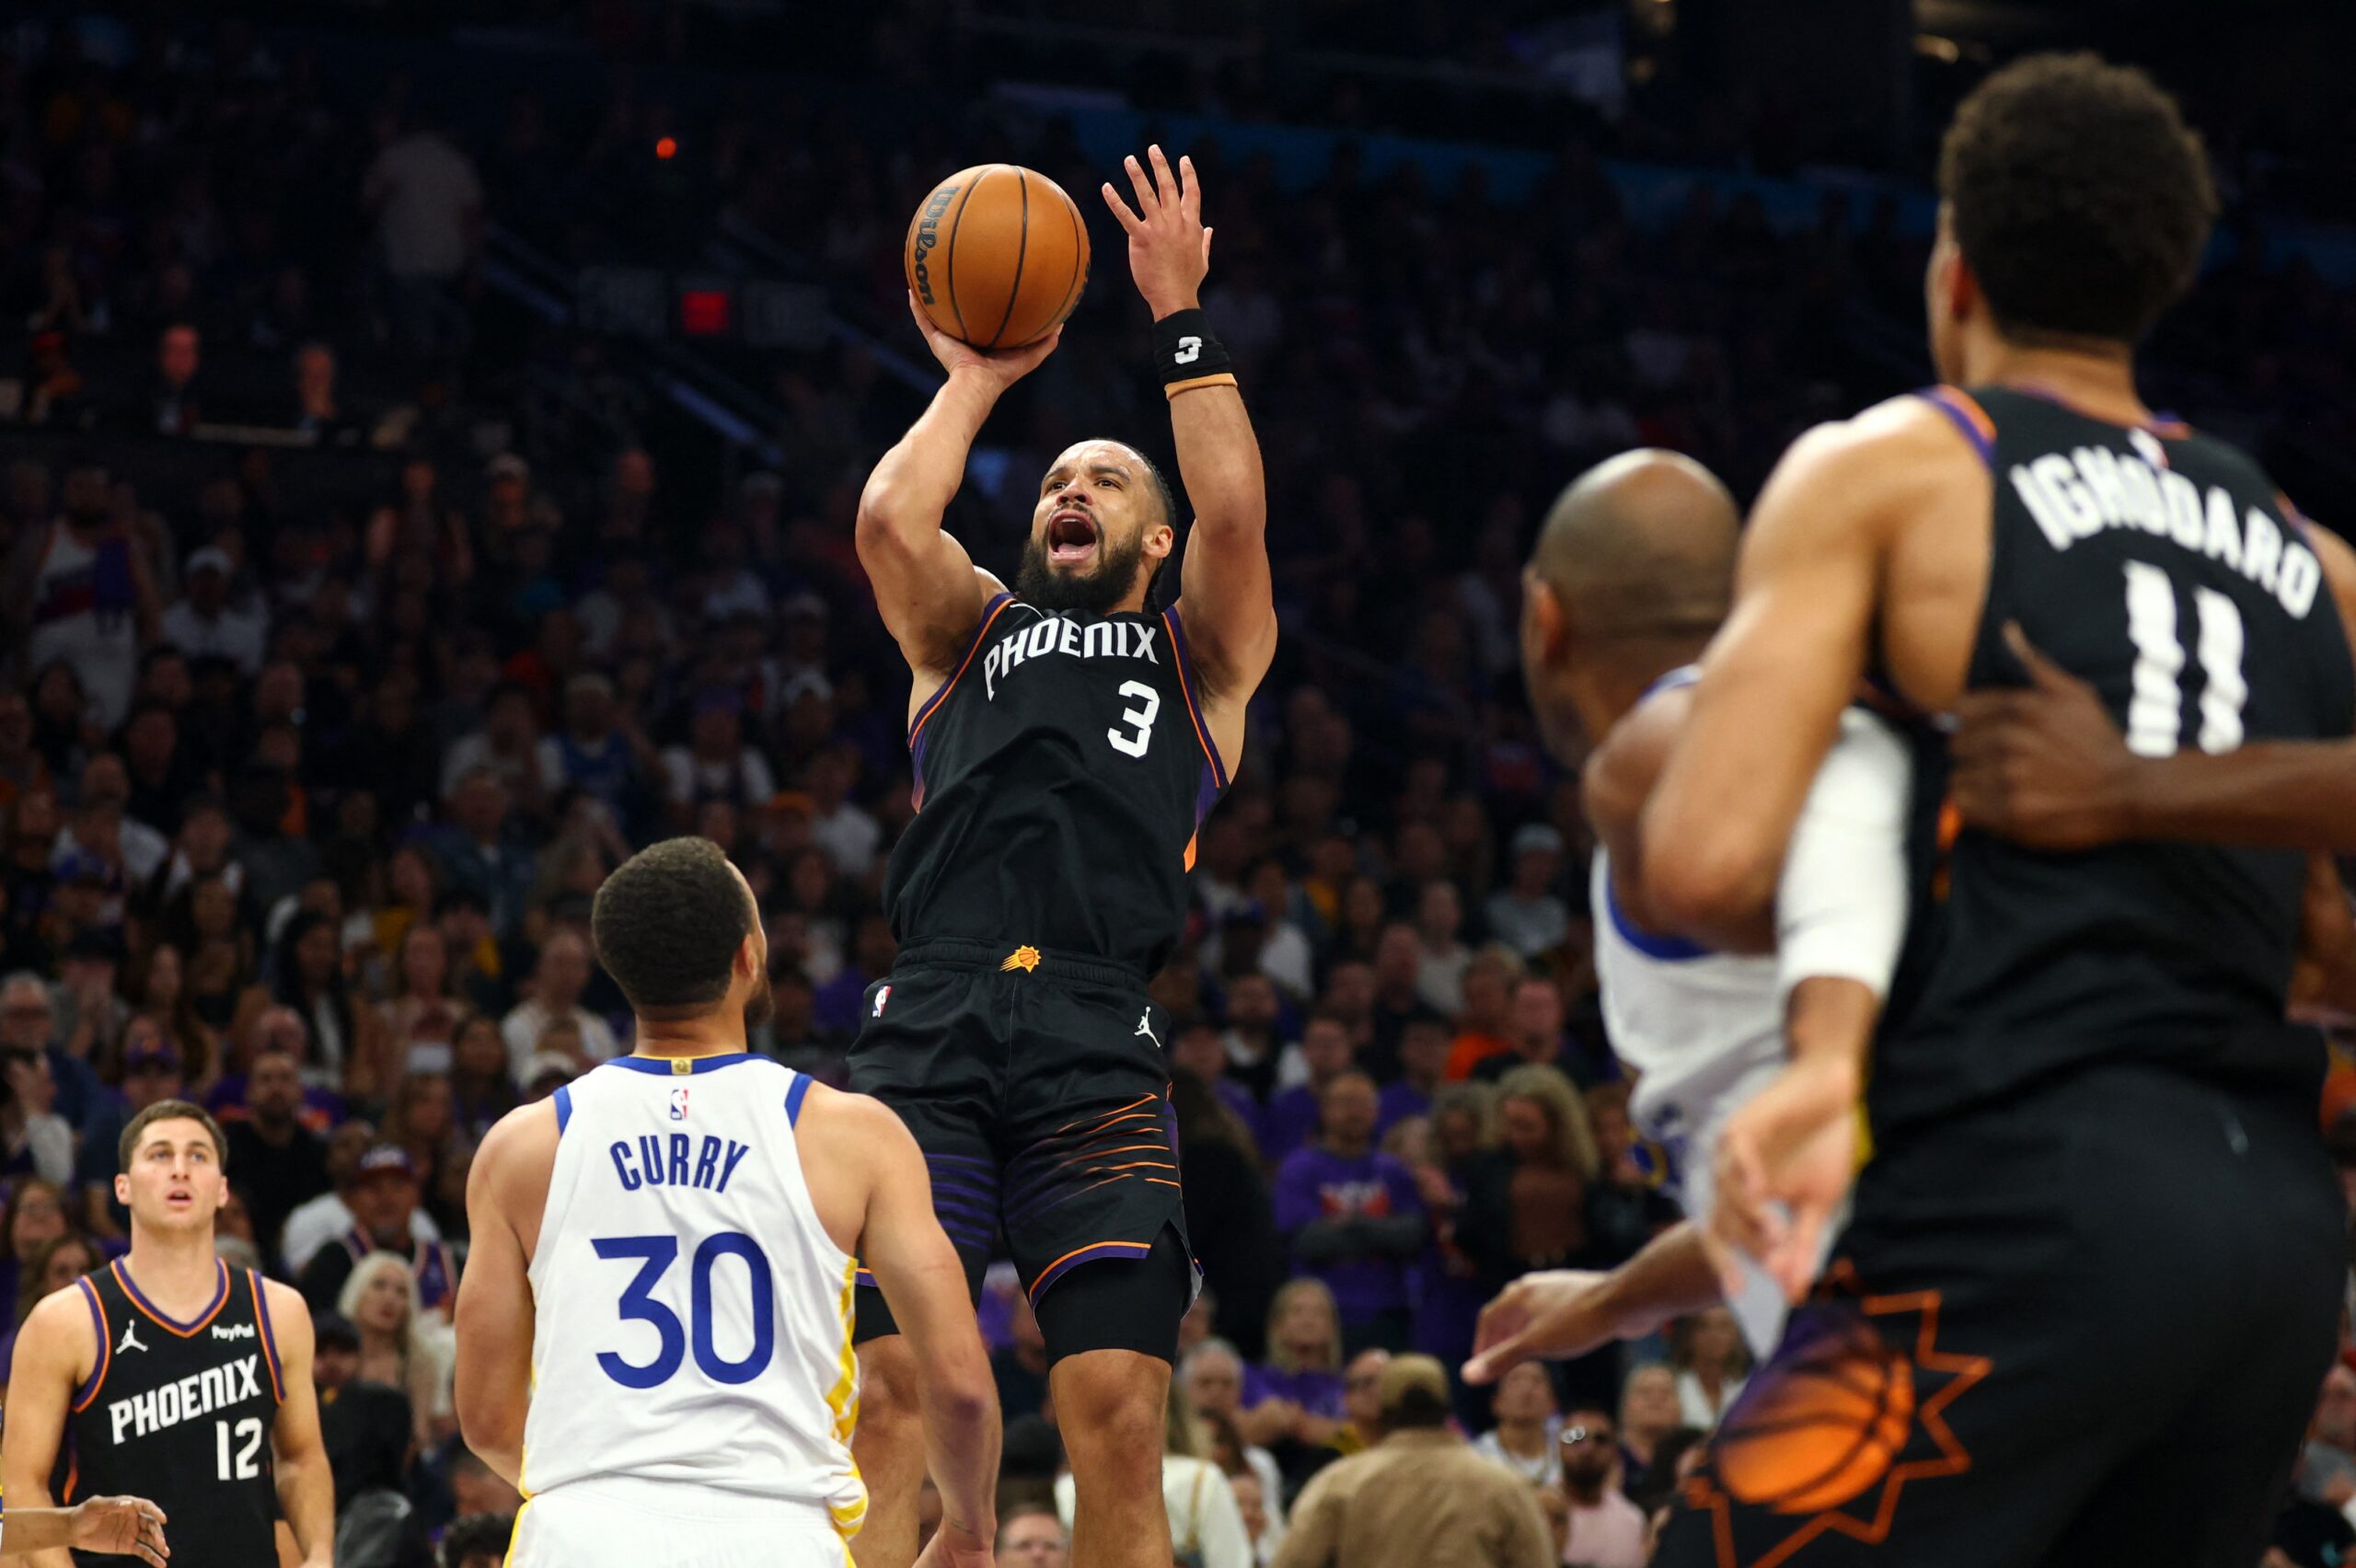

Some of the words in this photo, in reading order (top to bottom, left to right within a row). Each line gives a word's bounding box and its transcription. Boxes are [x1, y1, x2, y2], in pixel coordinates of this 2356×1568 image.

[915, 186, 961, 306] Wilson
[1174, 336, 1202, 364] 3
[984, 617, 1160, 702] PHOENIX
[2123, 558, 2248, 758] 11
[1107, 679, 1161, 758] 3
[609, 1133, 750, 1194] CURRY
[211, 1322, 255, 1342] PayPal
[590, 1231, 775, 1389] 30
[108, 1353, 262, 1446] PHOENIX
[215, 1416, 263, 1482] 12
